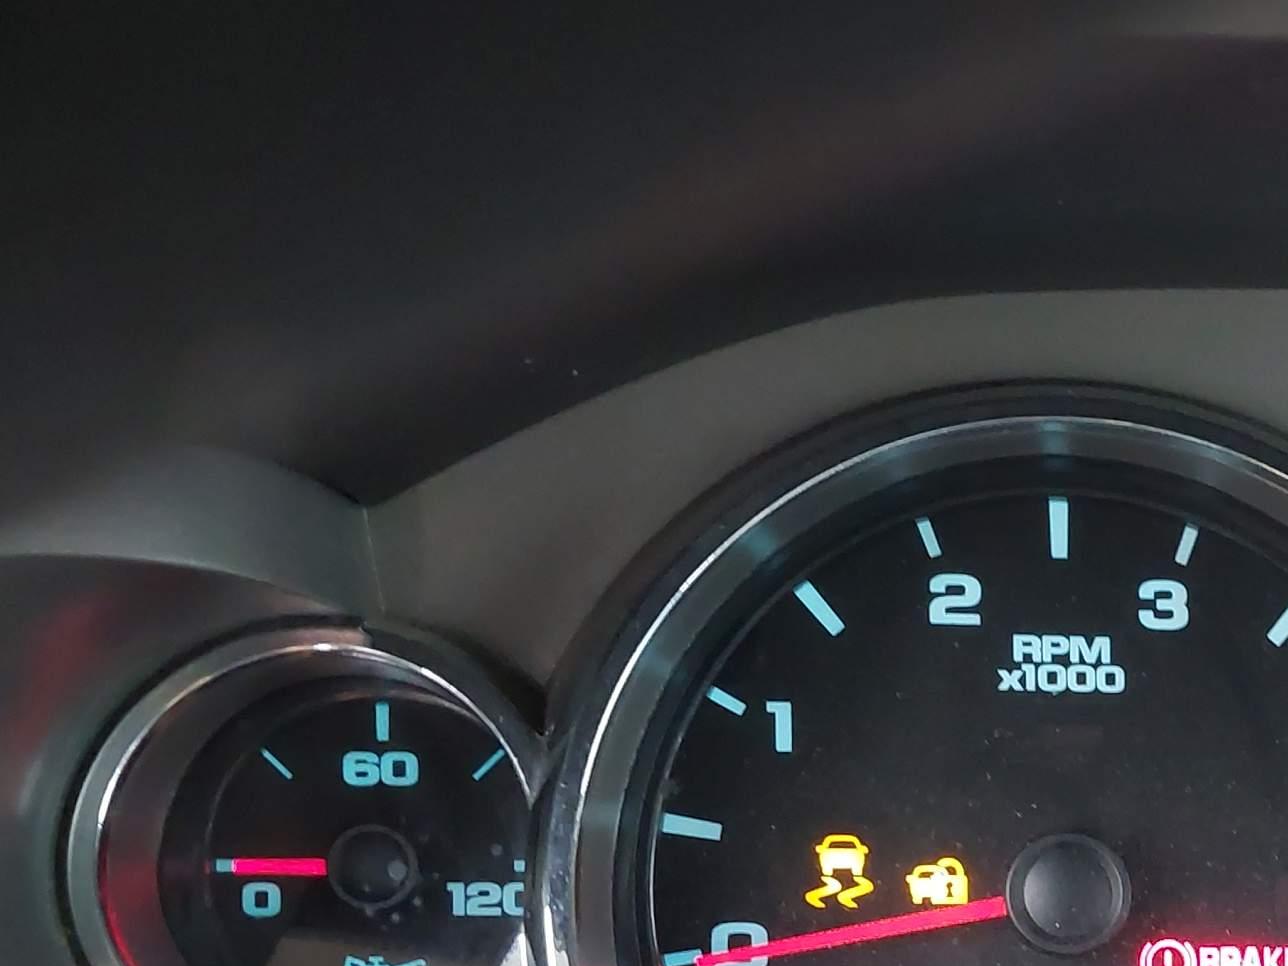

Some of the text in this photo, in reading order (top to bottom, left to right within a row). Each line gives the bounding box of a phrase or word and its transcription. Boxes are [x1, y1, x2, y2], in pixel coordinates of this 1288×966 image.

[929, 573, 981, 626] 2
[1138, 579, 1189, 631] 3
[1012, 633, 1112, 663] RPM
[998, 664, 1126, 693] x1000
[766, 701, 793, 753] 1
[342, 751, 419, 787] 60
[241, 882, 282, 917] 0
